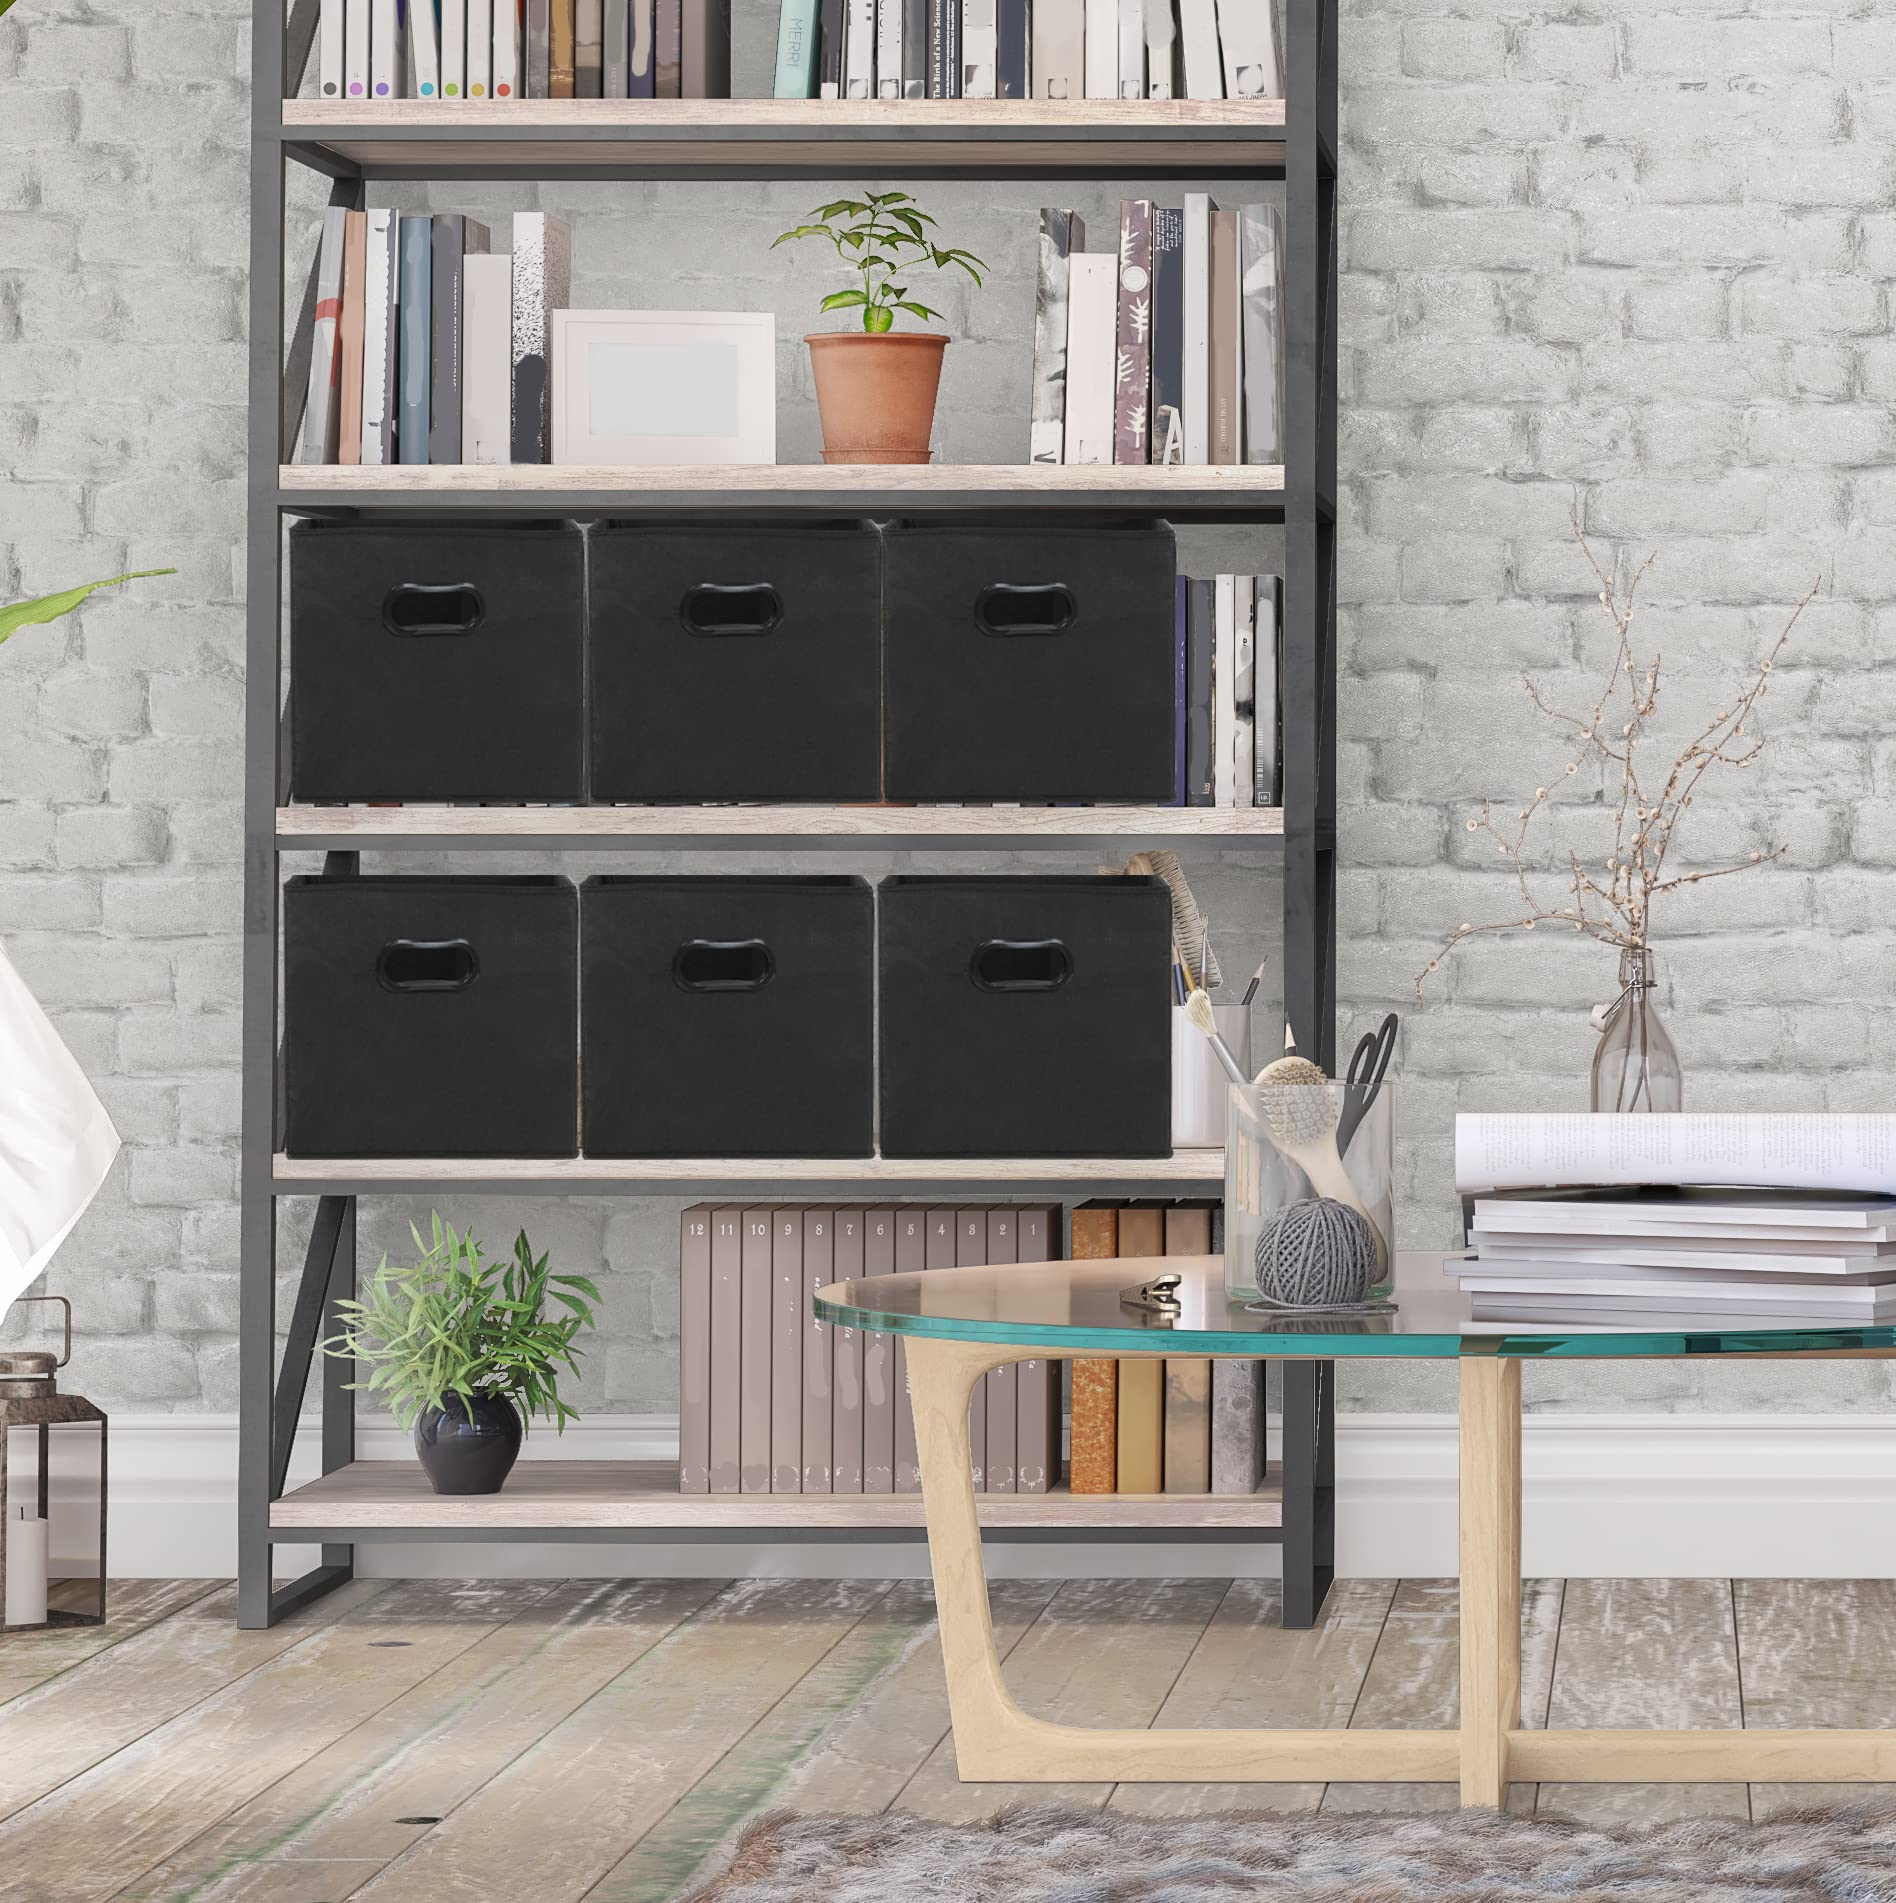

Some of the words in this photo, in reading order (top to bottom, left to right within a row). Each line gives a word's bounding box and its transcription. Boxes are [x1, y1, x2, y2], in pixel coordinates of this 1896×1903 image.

[933, 28, 941, 45] New
[933, 52, 941, 61] of
[933, 62, 941, 82] Birth
[933, 84, 941, 99] The
[689, 1223, 704, 1236] 12
[720, 1223, 733, 1236] 11
[751, 1223, 766, 1236] 10
[784, 1223, 792, 1236] 9
[815, 1223, 823, 1236] 8
[846, 1223, 854, 1236] 7
[876, 1223, 884, 1236] 6
[907, 1223, 915, 1236] 5
[938, 1223, 945, 1236] 4
[968, 1223, 976, 1236] 3
[999, 1223, 1007, 1236] 2
[1030, 1223, 1036, 1236] 1
